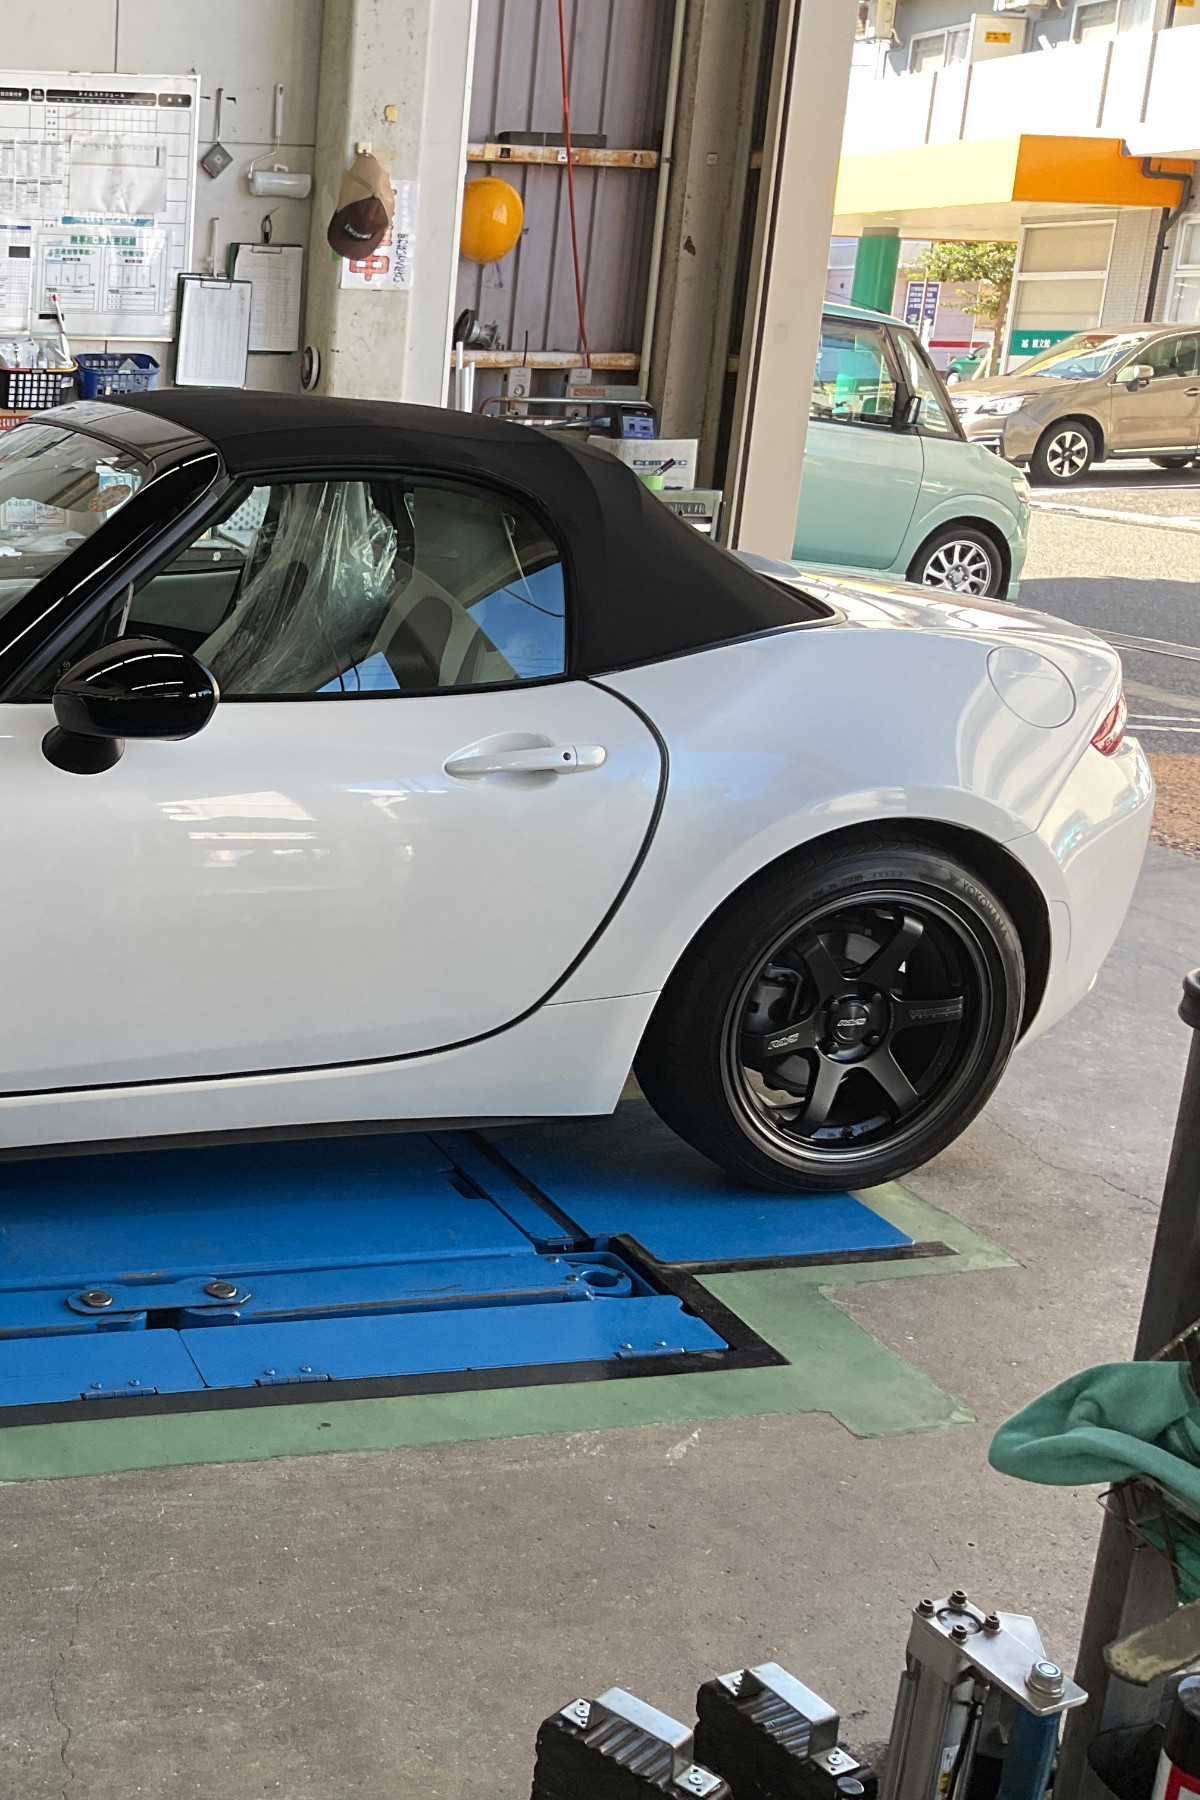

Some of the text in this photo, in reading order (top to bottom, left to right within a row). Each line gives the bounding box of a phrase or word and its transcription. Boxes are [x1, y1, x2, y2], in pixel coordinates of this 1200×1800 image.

[963, 880, 1008, 938] YOKOHAMA
[837, 1018, 867, 1027] RAYS
[767, 1032, 800, 1050] RAYS
